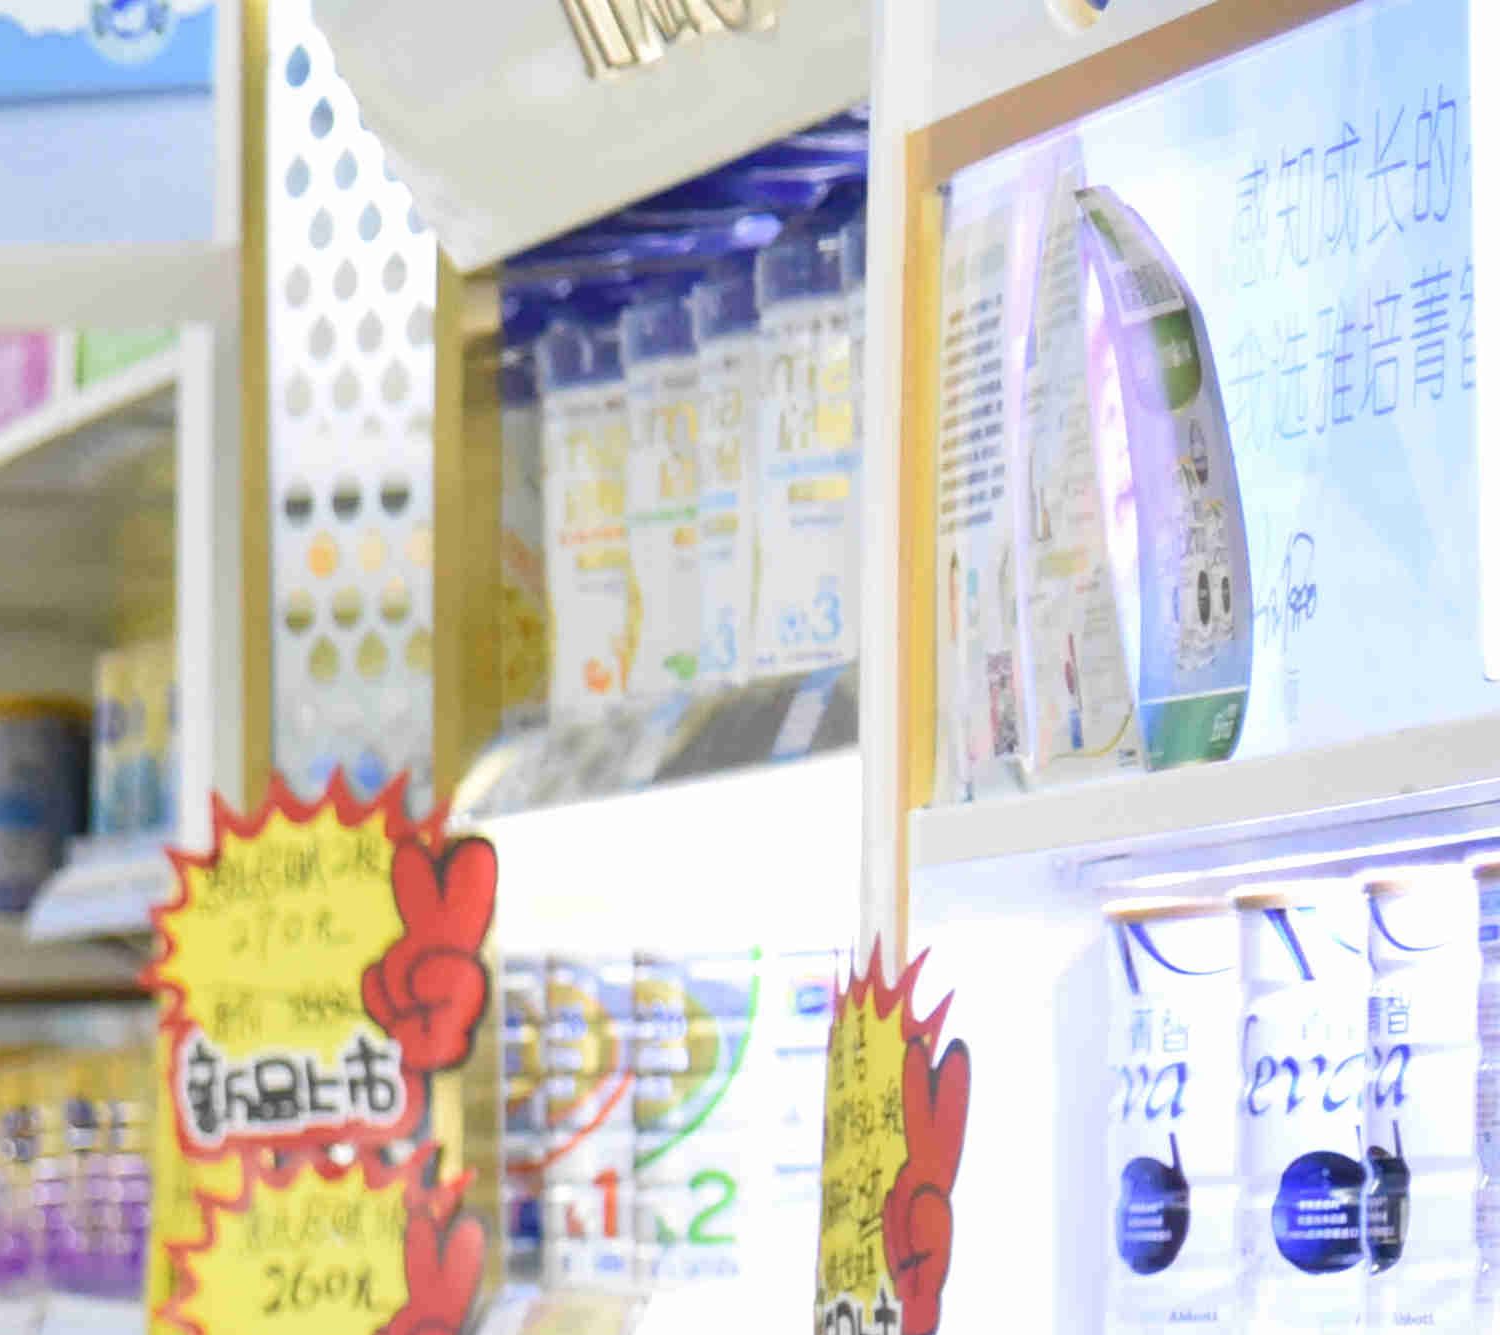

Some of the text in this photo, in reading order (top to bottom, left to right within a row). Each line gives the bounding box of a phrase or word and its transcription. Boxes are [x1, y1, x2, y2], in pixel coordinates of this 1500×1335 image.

[1235, 83, 1472, 290] 感知成长的
[186, 1036, 396, 1134] 新品上市
[593, 1167, 619, 1239] 1
[686, 1167, 739, 1245] 2
